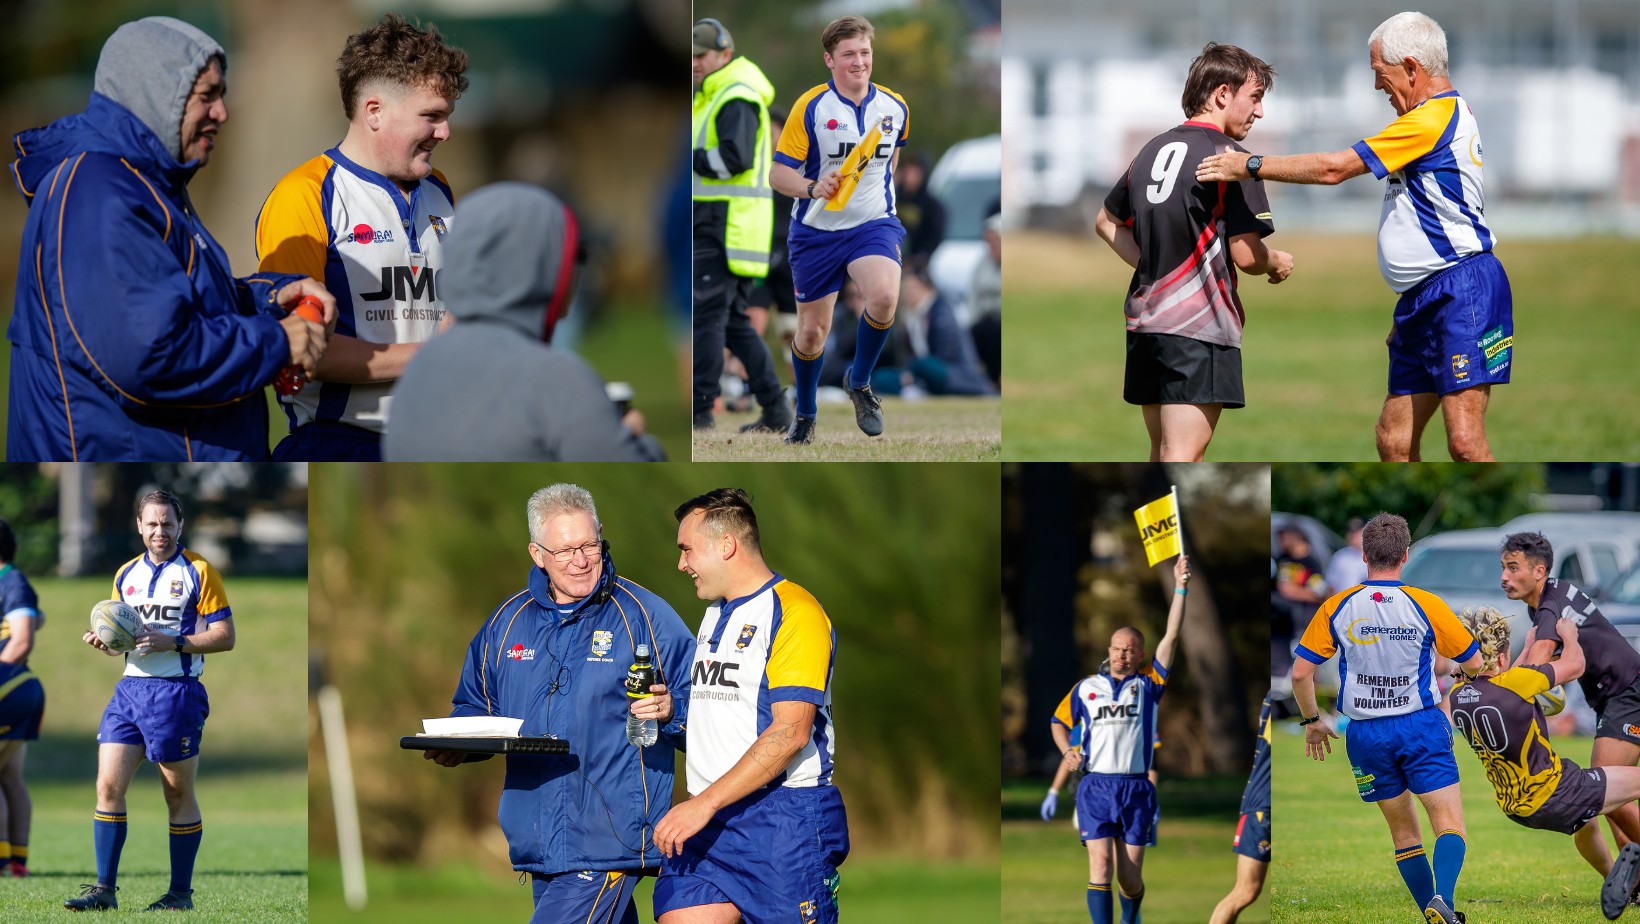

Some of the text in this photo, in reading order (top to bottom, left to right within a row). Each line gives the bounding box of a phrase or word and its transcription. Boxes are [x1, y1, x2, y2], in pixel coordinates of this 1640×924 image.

[1146, 141, 1188, 204] 9
[347, 229, 393, 243] SAMURAI
[358, 265, 439, 303] JM
[365, 308, 446, 321] CIVIL CONSTRUCT
[1142, 513, 1178, 541] JMC
[1360, 623, 1418, 635] generation
[691, 660, 740, 688] MC
[1356, 673, 1410, 688] REMEMBER
[1371, 687, 1395, 699] I'M A
[1354, 695, 1410, 709] VOLUNTEER
[1093, 703, 1140, 721] JMC
[1452, 705, 1508, 753] 20
